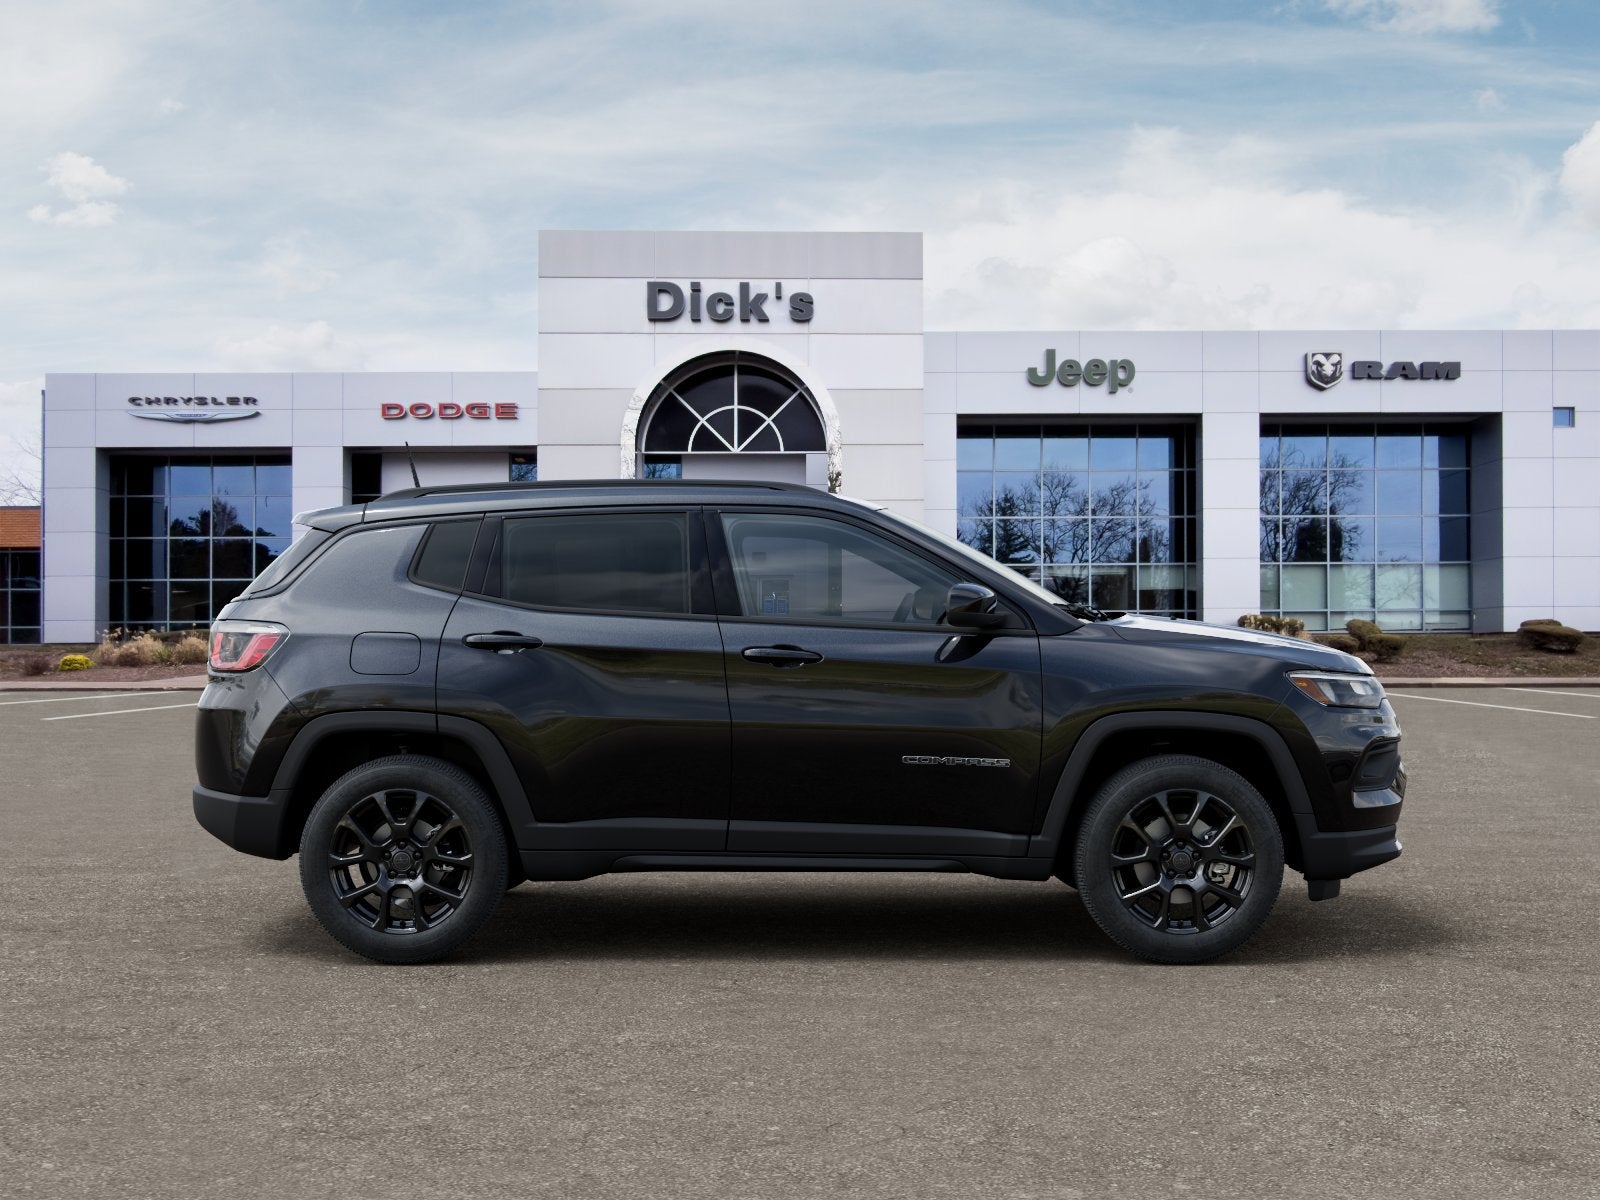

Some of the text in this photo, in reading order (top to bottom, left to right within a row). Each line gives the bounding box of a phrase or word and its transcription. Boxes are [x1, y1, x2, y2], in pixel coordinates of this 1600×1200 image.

[647, 282, 814, 322] Dick's
[1027, 348, 1136, 393] Jeep
[1352, 361, 1461, 380] RAM
[128, 396, 259, 406] CHRYSLER
[381, 403, 519, 419] DODGE
[902, 755, 1011, 768] COMPASS
